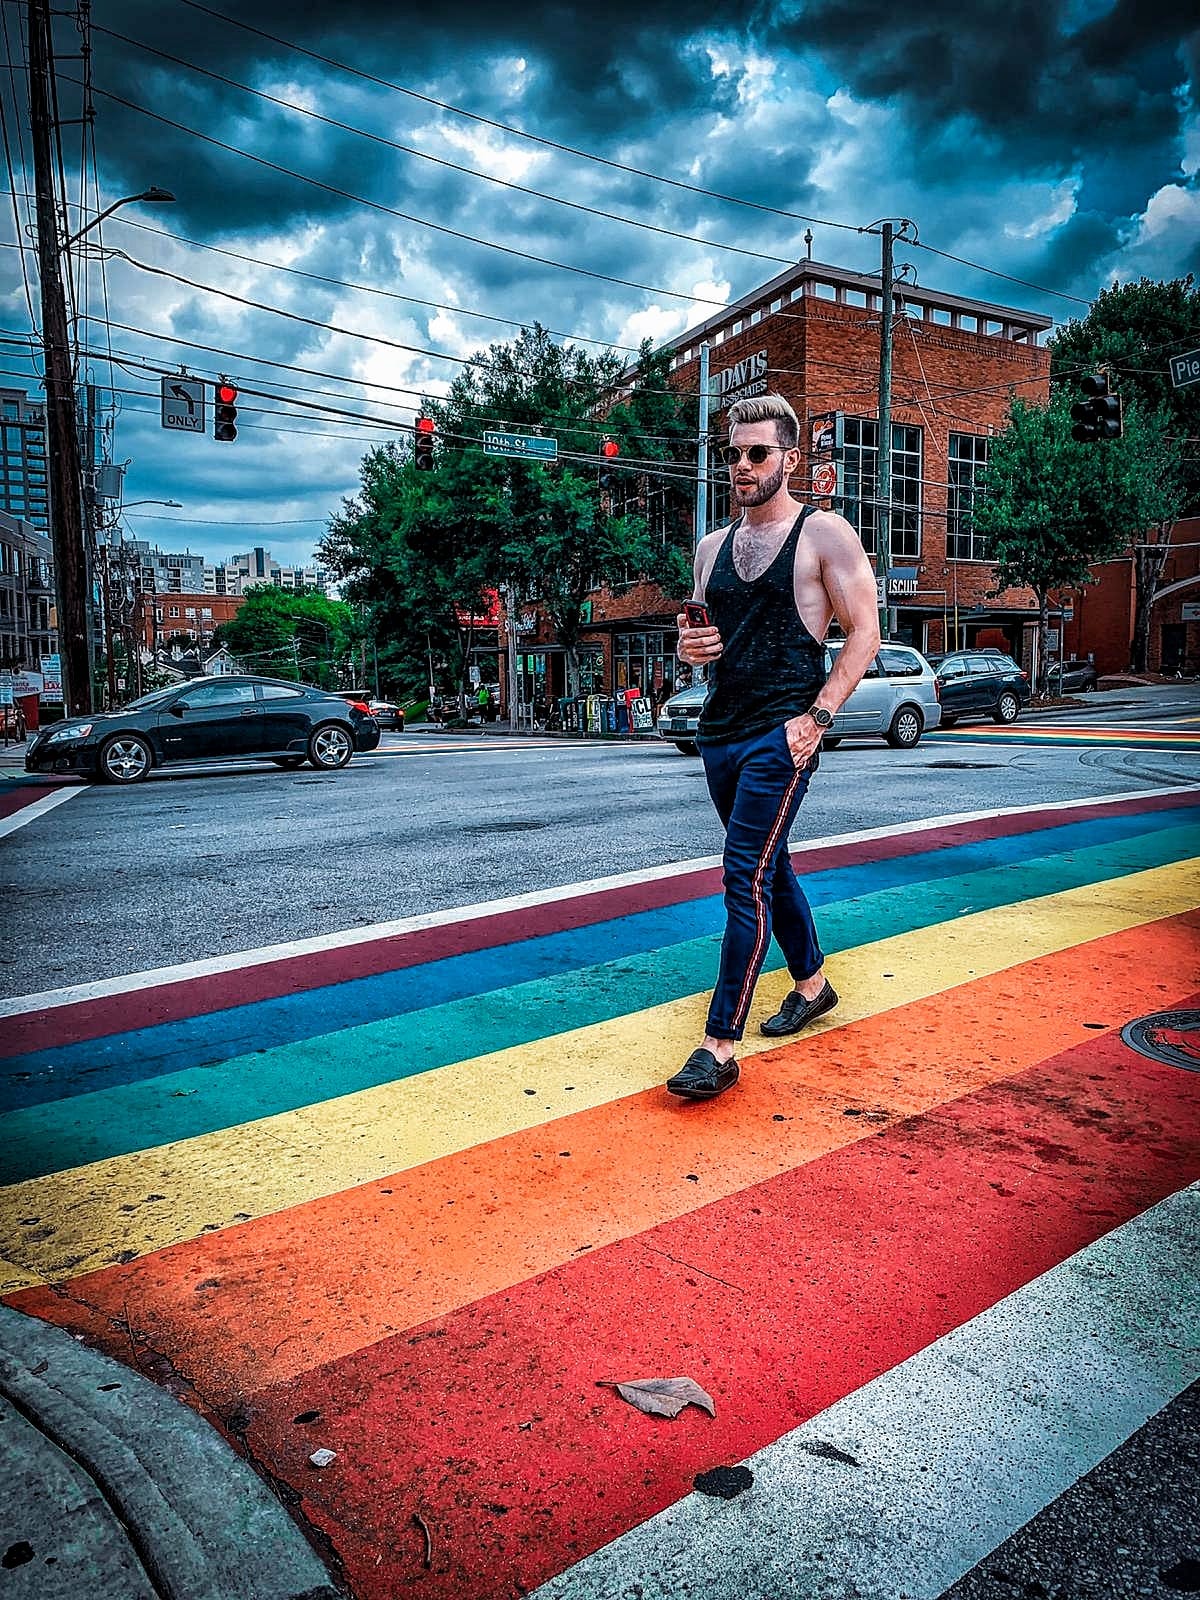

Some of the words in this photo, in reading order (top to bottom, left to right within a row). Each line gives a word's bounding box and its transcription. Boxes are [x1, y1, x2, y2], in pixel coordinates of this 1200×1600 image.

[721, 350, 768, 393] DAVIS
[167, 415, 199, 427] ONLY
[487, 436, 510, 451] 10th
[888, 579, 918, 594] ISCUIT
